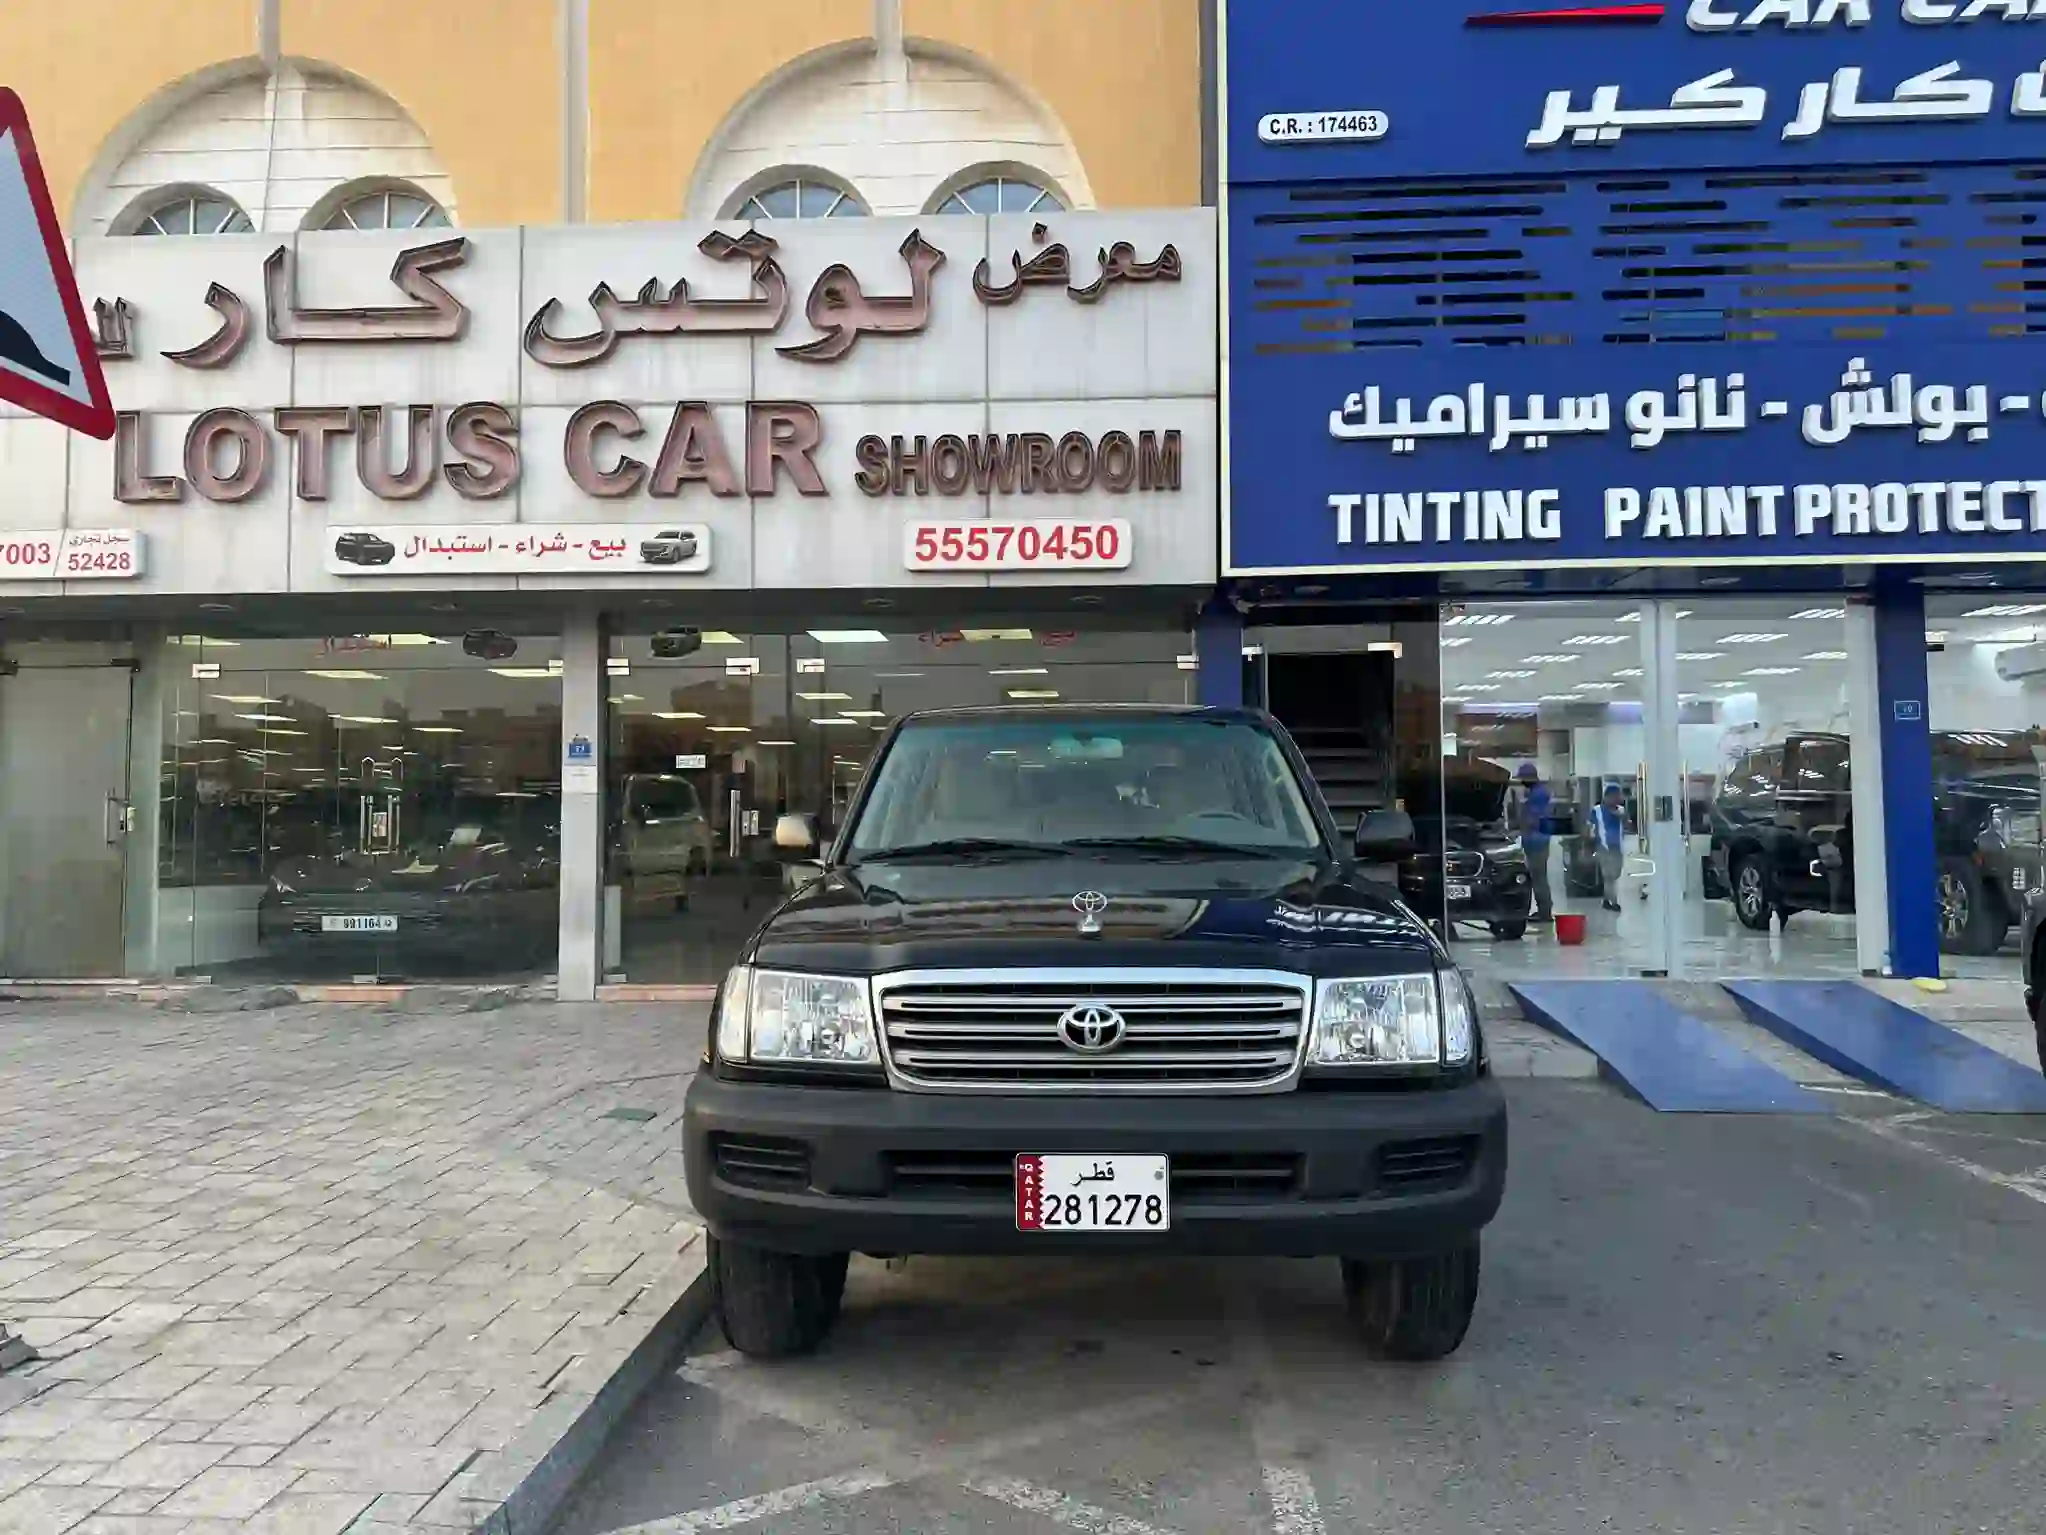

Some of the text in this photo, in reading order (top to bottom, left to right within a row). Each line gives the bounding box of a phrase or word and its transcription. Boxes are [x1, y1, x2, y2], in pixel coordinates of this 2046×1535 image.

[1317, 115, 1378, 133] 174463
[1525, 68, 1767, 148] كير
[1782, 60, 1994, 141] كار
[971, 222, 1183, 305] معرض
[159, 236, 472, 371] كار
[523, 228, 946, 369] لوتس
[1328, 382, 1611, 454] سيراميك
[1625, 372, 1747, 449] نانو
[1801, 357, 1990, 446] بولش
[113, 400, 830, 503] LOTUS CAR
[854, 428, 1183, 498] SHOWROOM
[515, 532, 567, 558] شراء
[915, 525, 1119, 562] 55570450
[1328, 488, 1562, 545] TINTING
[1603, 484, 1785, 540] PAINT
[0, 543, 51, 565] 003
[68, 551, 131, 571] 52428
[403, 535, 493, 561] استبدال
[587, 535, 627, 561] بيع
[1023, 1163, 1034, 1221] QATAR
[1070, 1160, 1115, 1187] قطر
[1044, 1193, 1163, 1226] 281278
